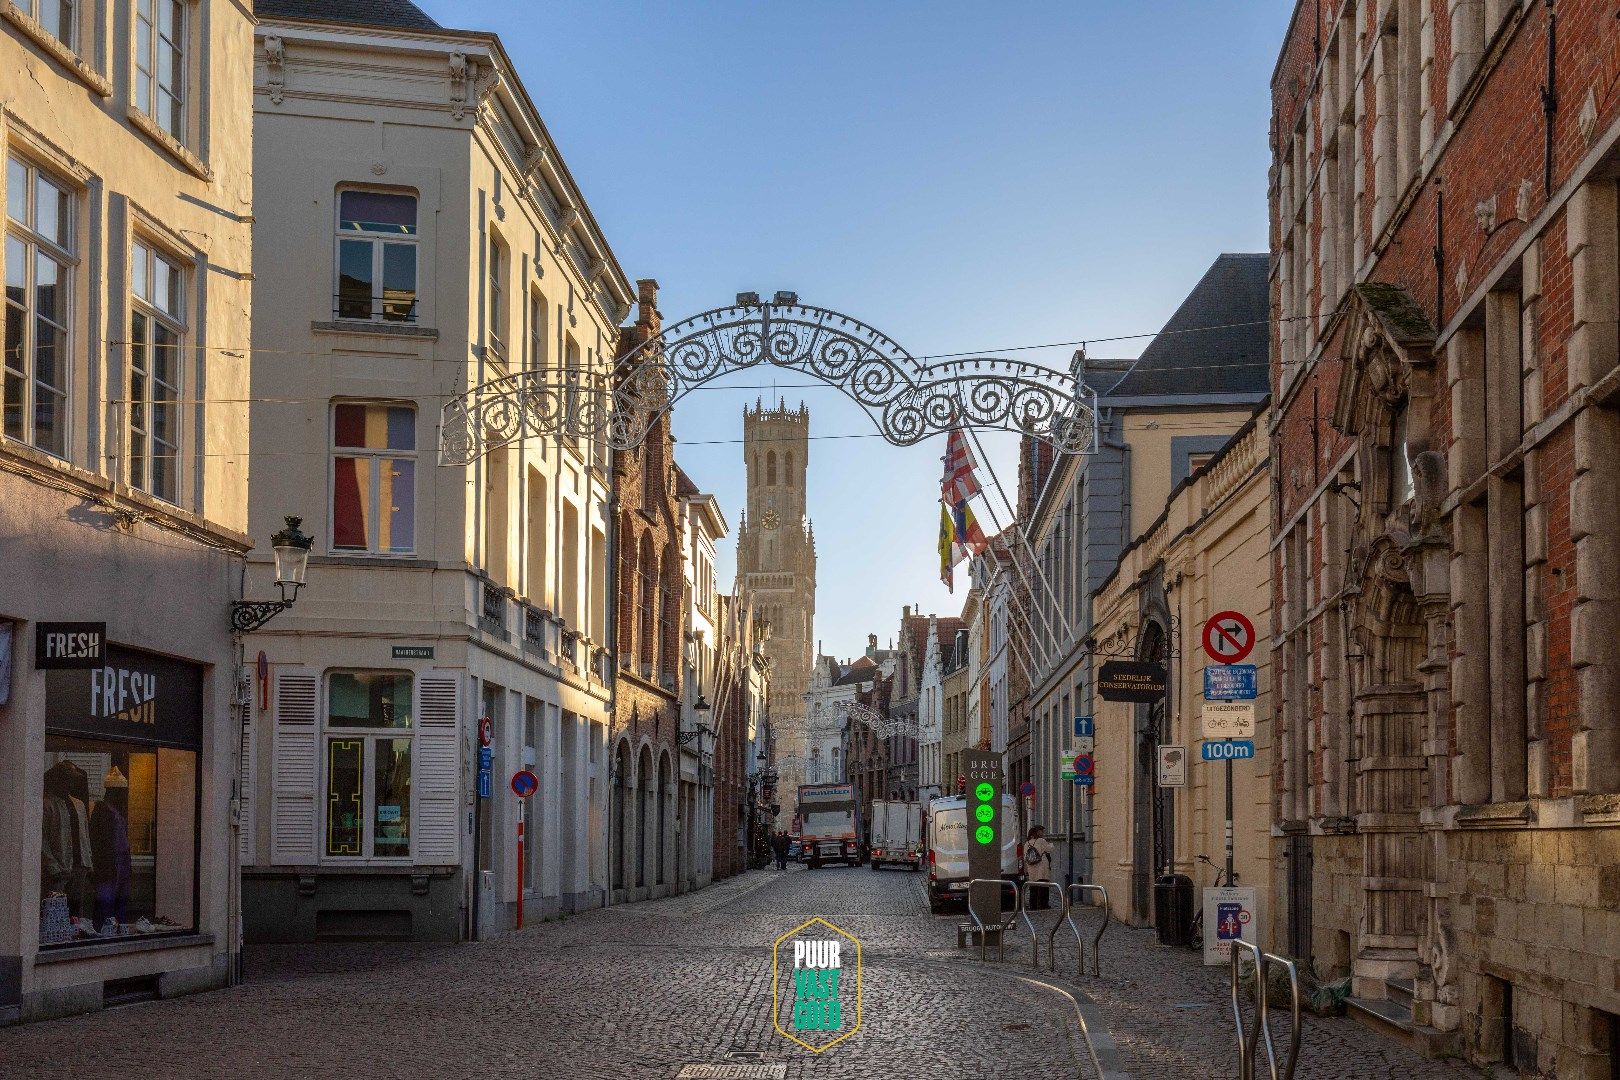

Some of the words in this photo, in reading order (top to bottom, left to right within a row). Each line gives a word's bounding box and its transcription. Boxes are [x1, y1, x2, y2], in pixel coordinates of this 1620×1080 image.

[46, 632, 99, 658] FRESH
[1113, 674, 1152, 682] STEDELIJK
[1099, 680, 1165, 691] CONSERVATORIUM
[91, 664, 156, 724] FRESH
[1207, 743, 1249, 758] 100m
[970, 760, 999, 769] BRU
[970, 770, 998, 780] GGE
